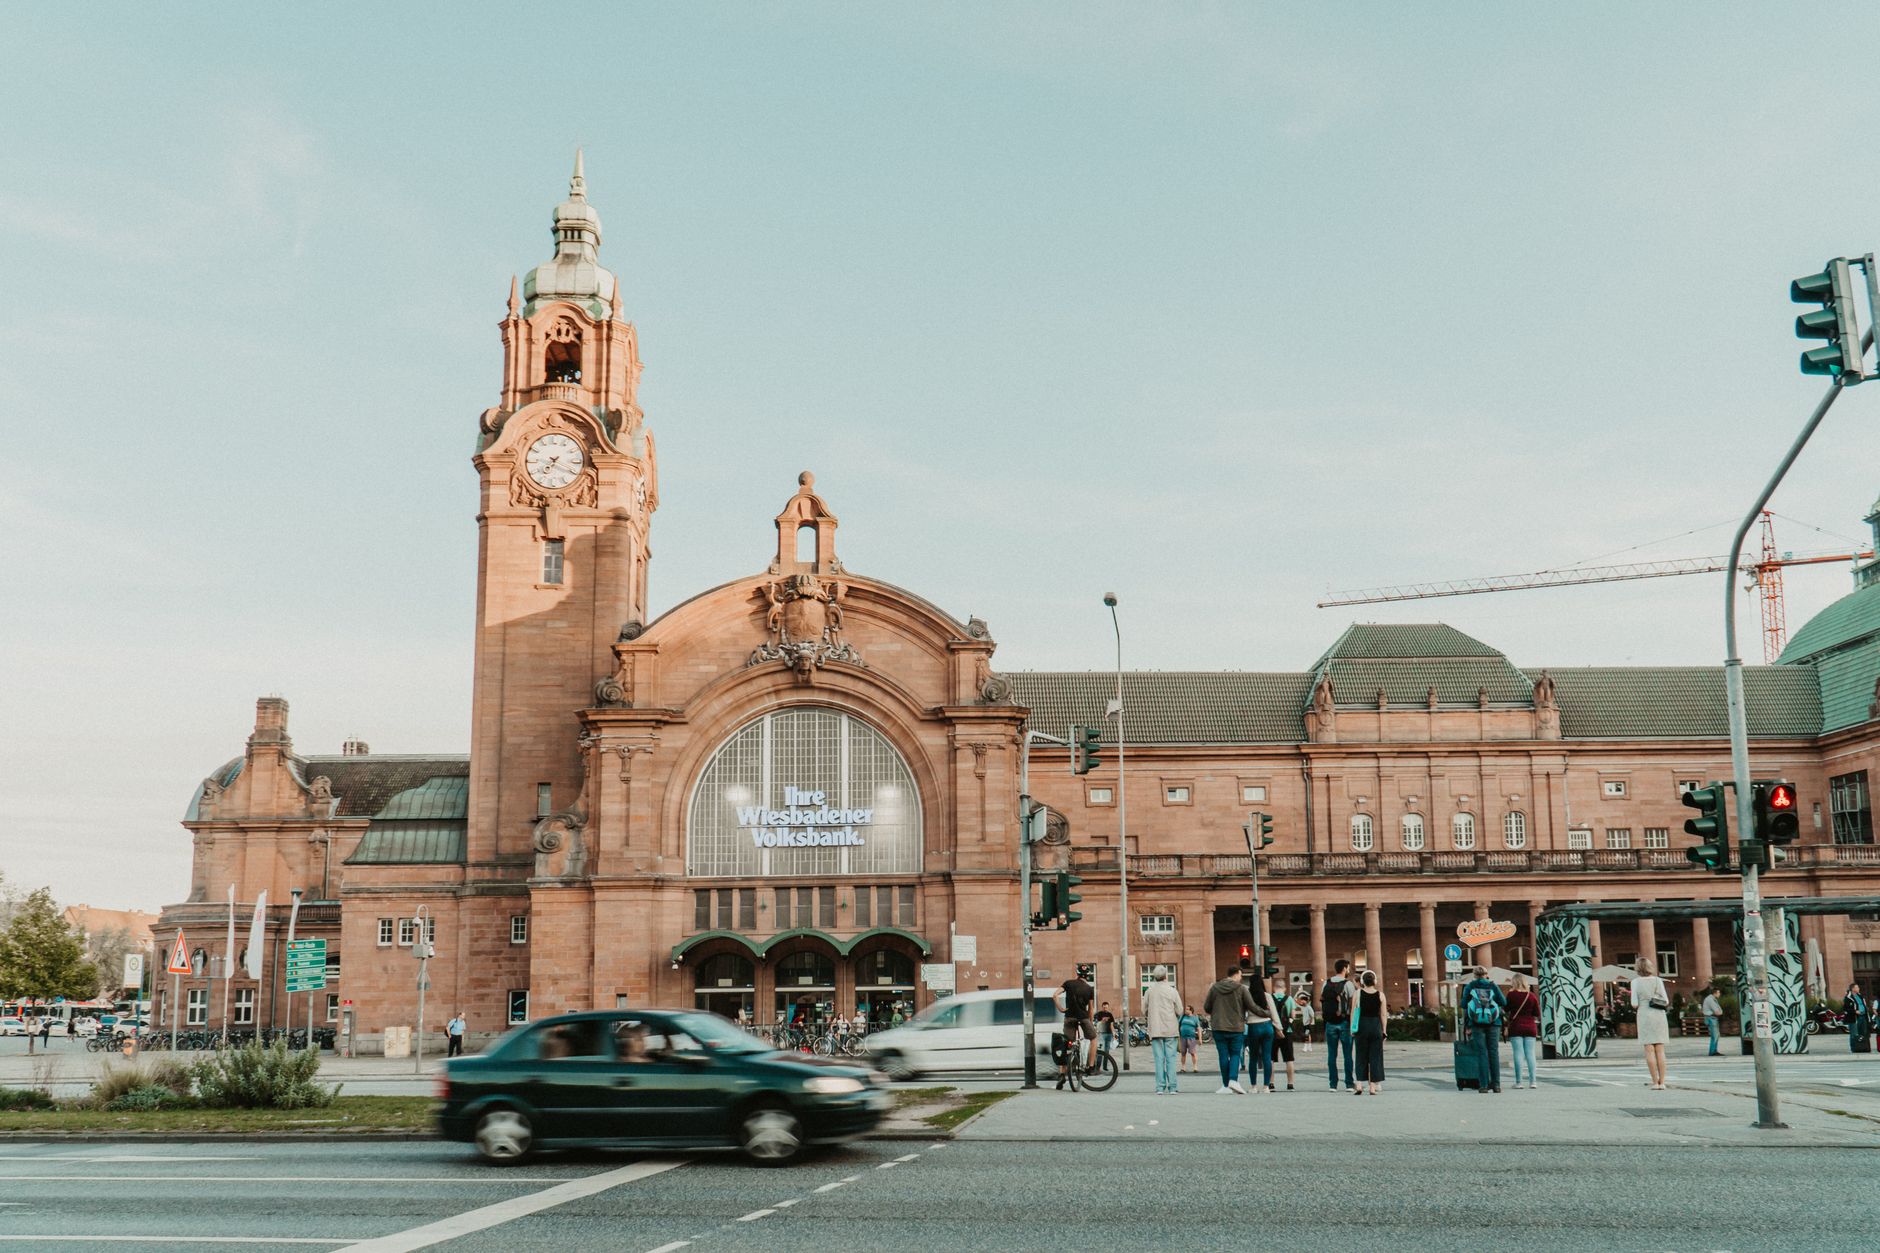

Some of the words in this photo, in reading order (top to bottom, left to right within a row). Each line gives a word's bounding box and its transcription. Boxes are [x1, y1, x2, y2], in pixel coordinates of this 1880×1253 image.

[784, 786, 826, 806] Ihre
[736, 805, 874, 826] Wiesbadener
[752, 827, 865, 848] Volksbank.
